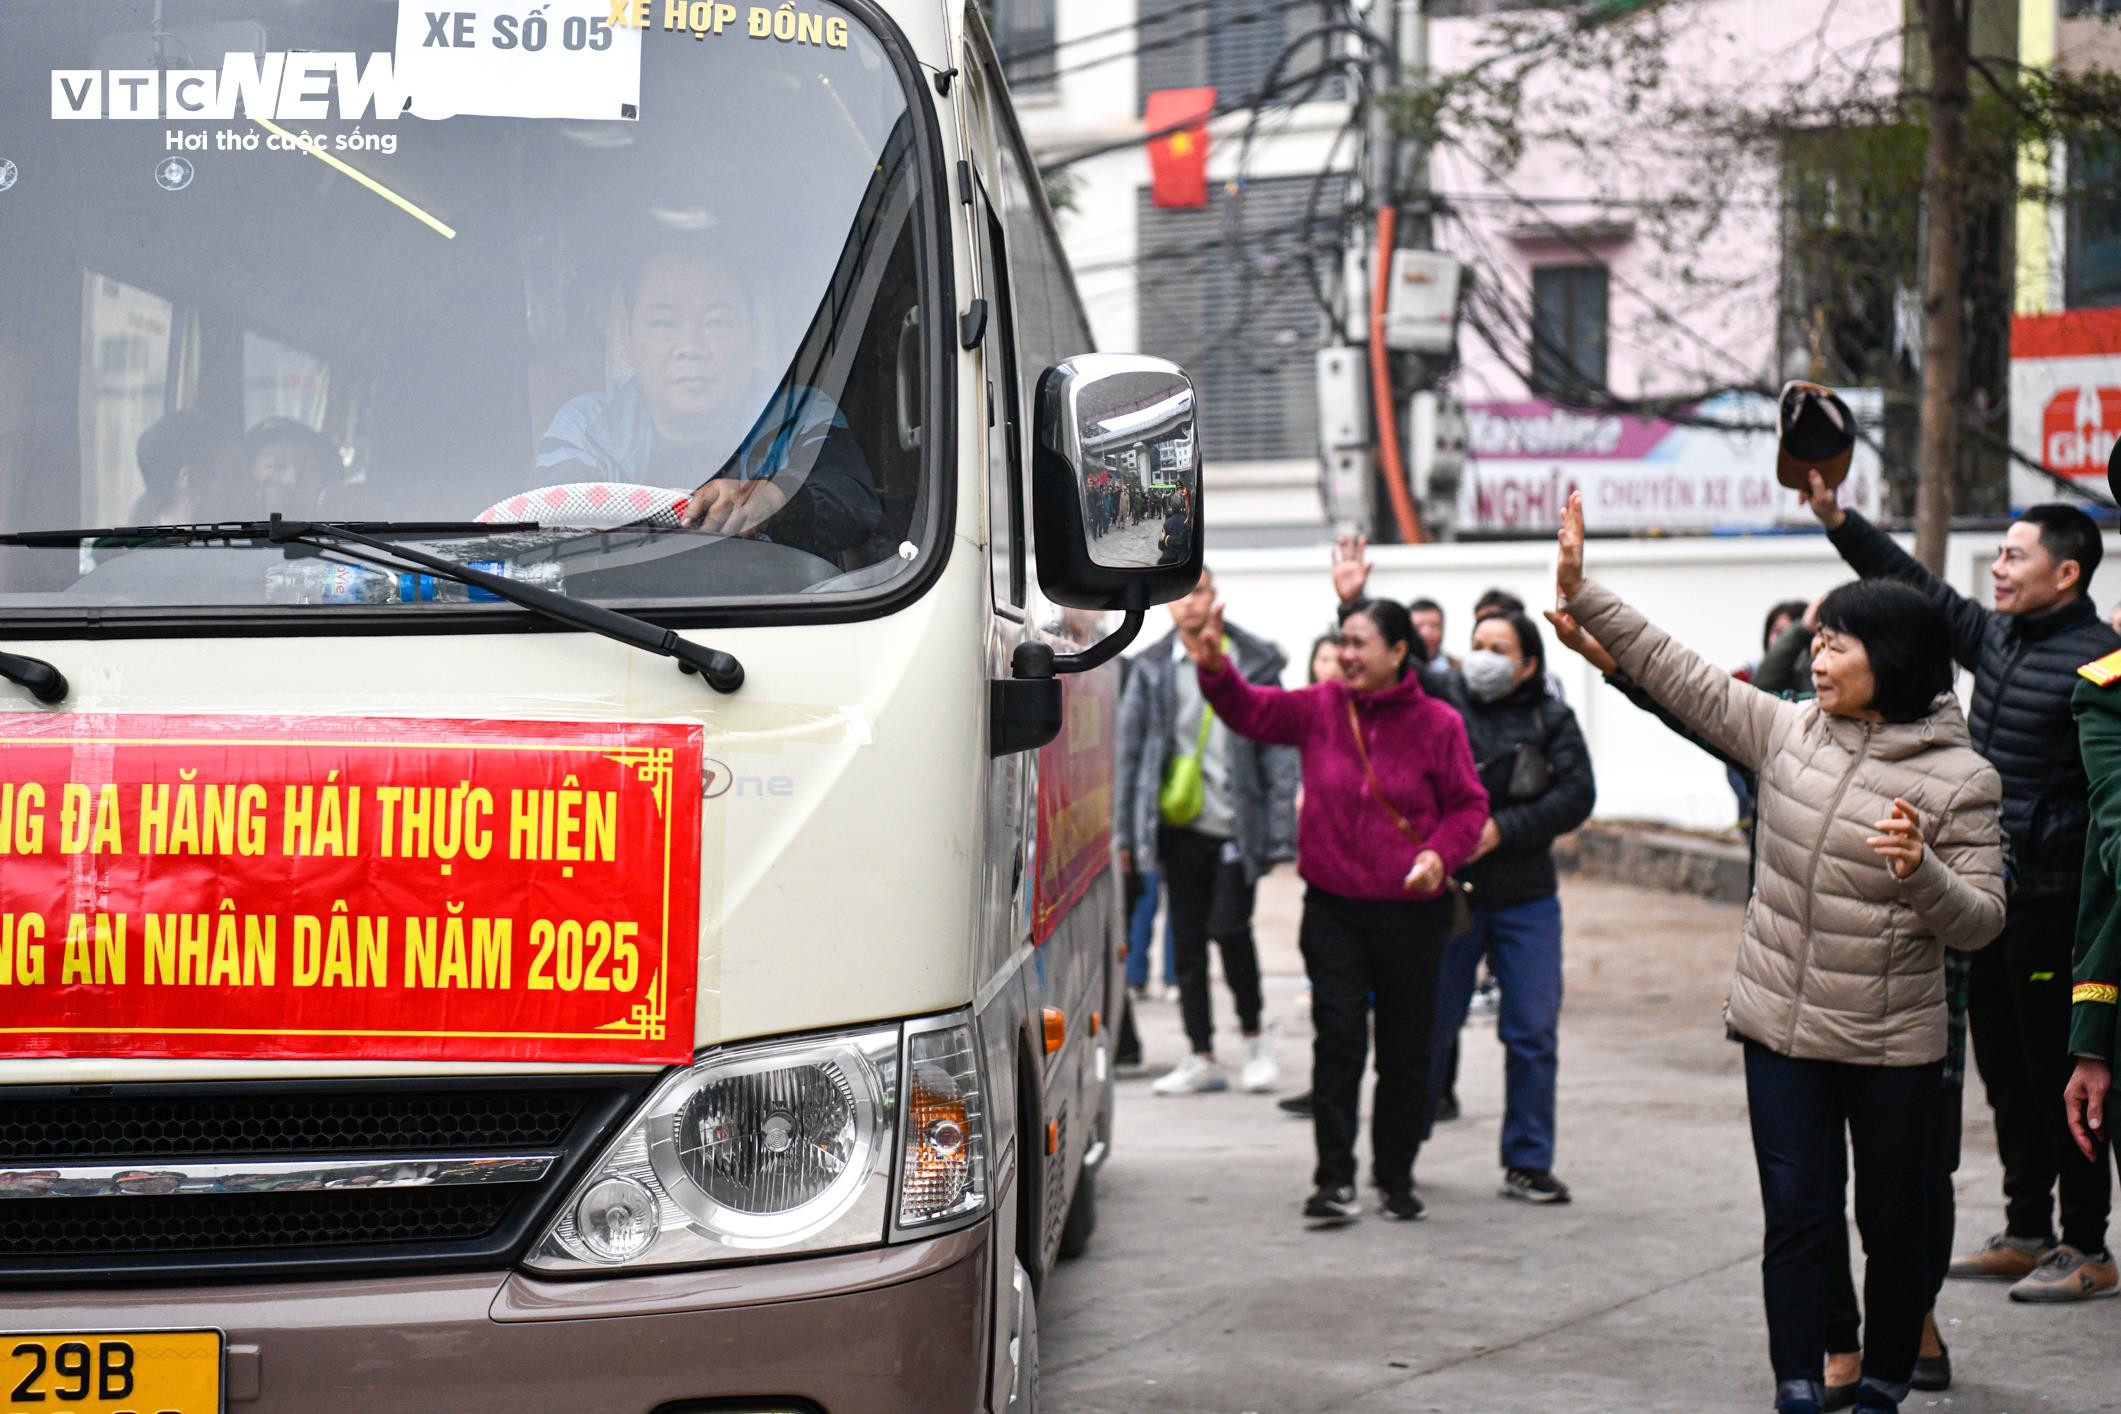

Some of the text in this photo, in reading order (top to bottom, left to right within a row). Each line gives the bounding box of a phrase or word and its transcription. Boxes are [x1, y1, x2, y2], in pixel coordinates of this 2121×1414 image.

[422, 4, 613, 52] XE SỐ 05
[606, 0, 849, 50] XE HỢP ĐỒNG
[60, 783, 123, 855] ĐA
[139, 768, 267, 856] HĂNG
[283, 770, 361, 857] HÁI
[376, 780, 494, 876] THỰC
[509, 774, 617, 878] HIỆN
[62, 913, 127, 985] AN
[144, 898, 276, 986] NHÂN
[293, 899, 389, 988] DÂN
[404, 901, 513, 989] NĂM
[527, 918, 639, 992] 2025
[10, 1342, 134, 1403] 29B
